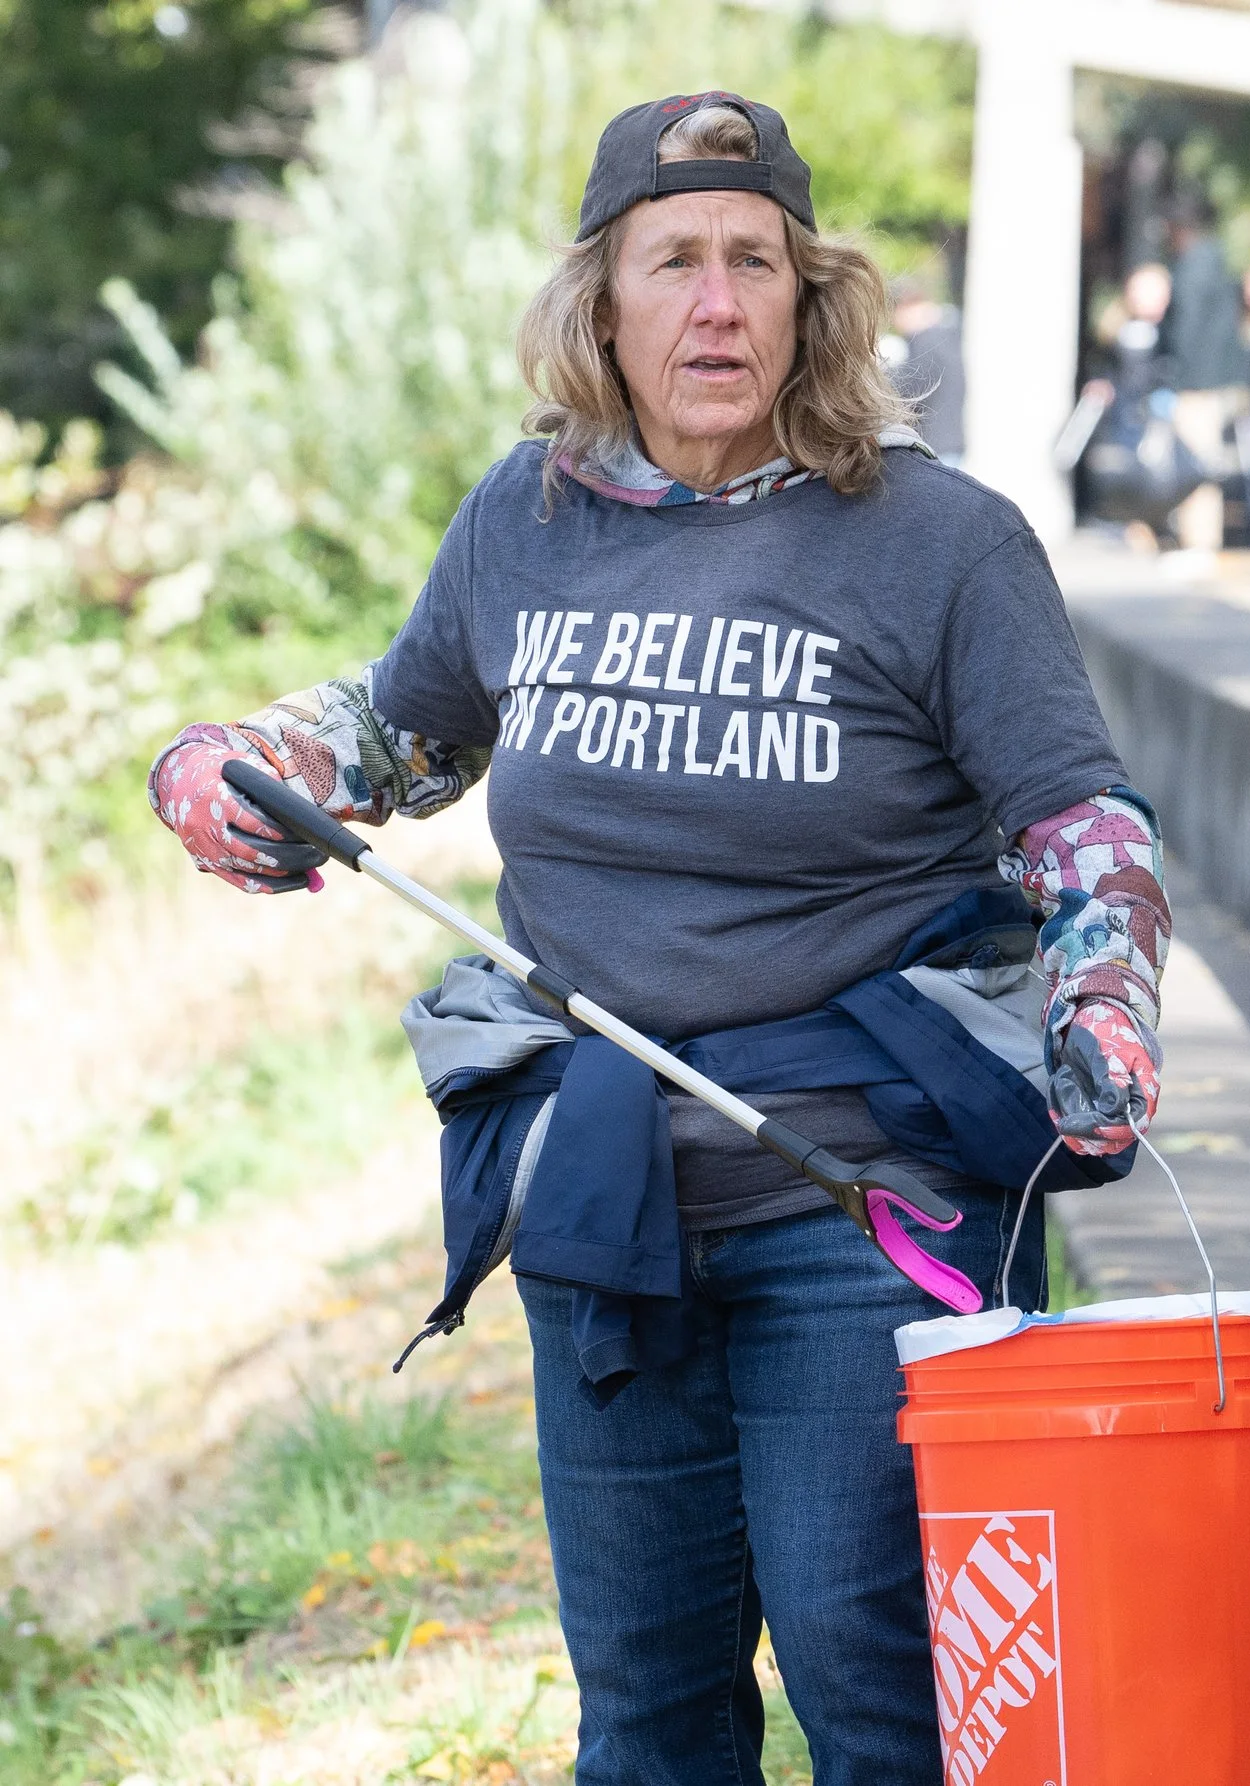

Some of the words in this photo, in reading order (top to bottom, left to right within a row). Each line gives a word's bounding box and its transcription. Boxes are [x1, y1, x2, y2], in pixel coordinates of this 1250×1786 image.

[508, 610, 594, 686] WE
[591, 612, 840, 705] BELIEVE
[499, 685, 545, 751] IN
[540, 691, 840, 783] PORTLAND
[931, 1516, 1053, 1778] OME
